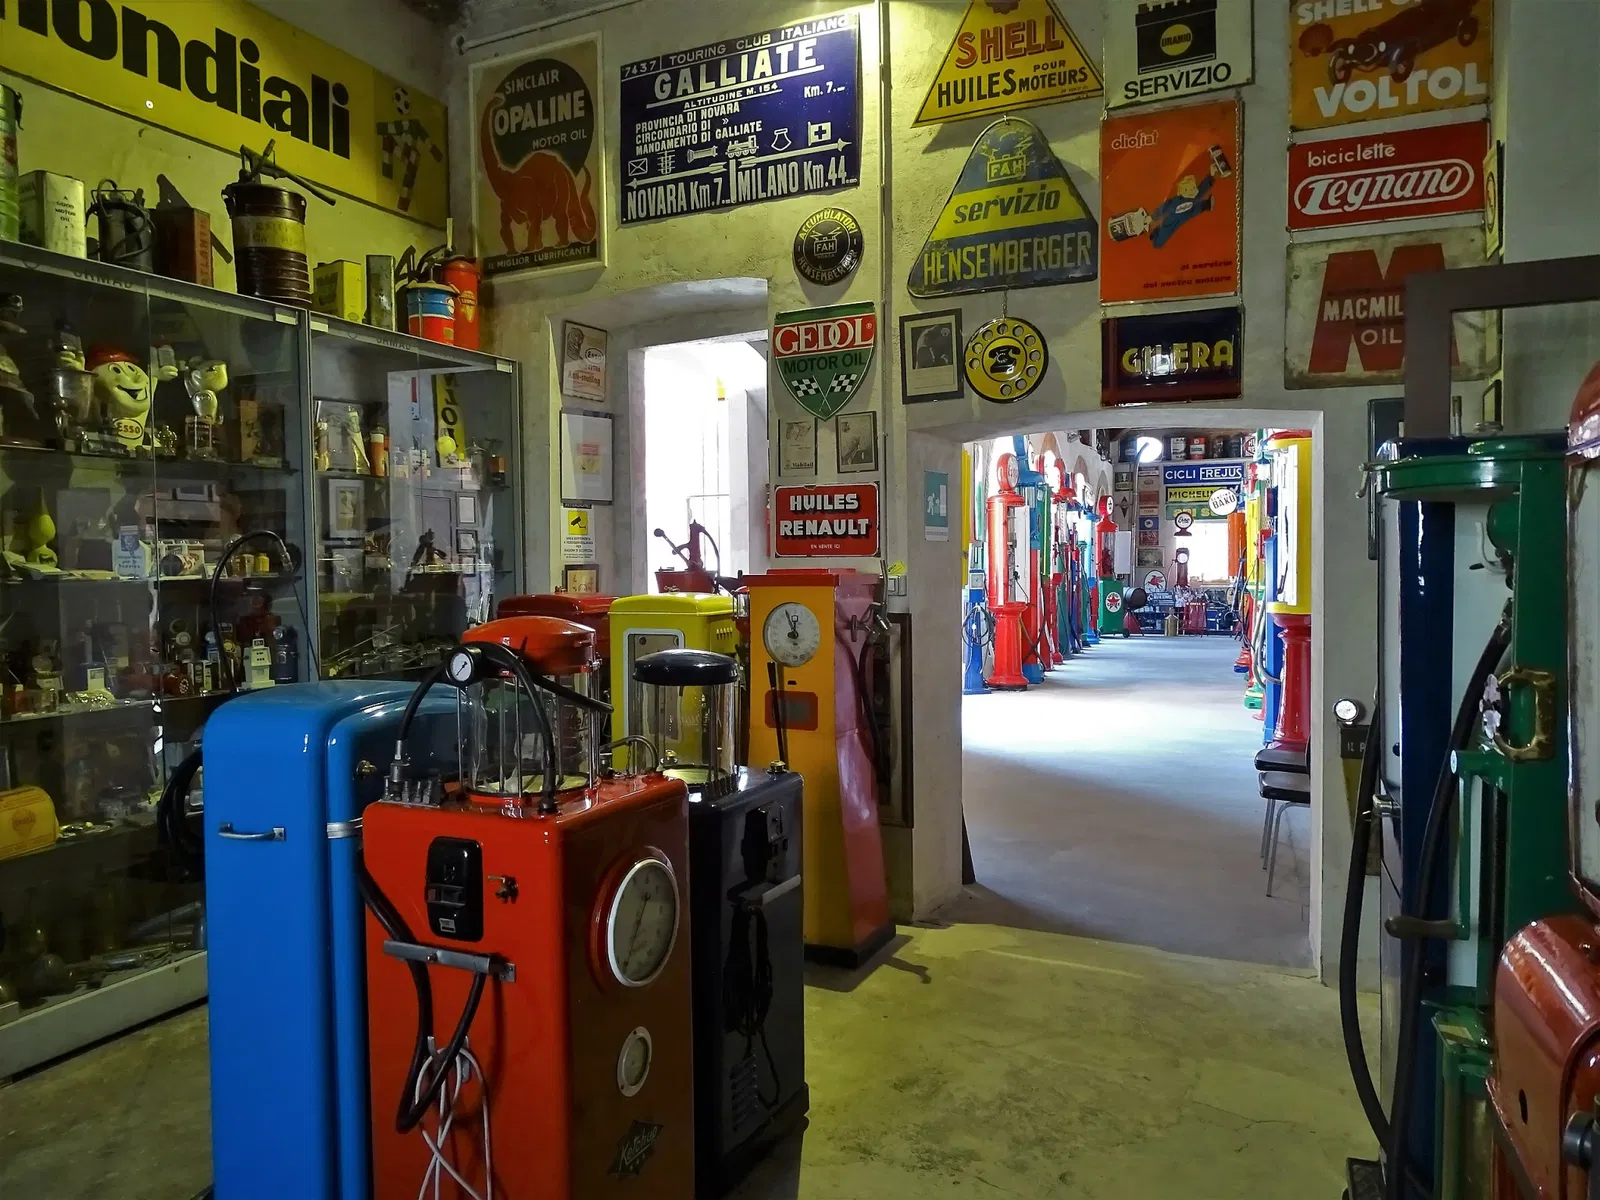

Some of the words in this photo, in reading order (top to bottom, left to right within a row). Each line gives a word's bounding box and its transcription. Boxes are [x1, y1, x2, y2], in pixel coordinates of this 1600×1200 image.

[625, 61, 656, 78] 7437
[669, 44, 726, 66] TOURING
[736, 33, 771, 50] CLUB
[781, 15, 850, 41] ITALIANO
[955, 15, 1064, 69] SHELL
[654, 38, 817, 101] GALLIATE
[1033, 60, 1066, 73] POUR
[504, 69, 559, 95] SINCLAIR
[804, 85, 824, 98] Km.
[938, 69, 1016, 108] HUILES
[1018, 66, 1088, 93] MOTEURS
[1124, 62, 1231, 100] SERVIZIO
[1313, 62, 1487, 118] VOLTOL
[494, 89, 585, 136] OPALINE
[684, 89, 743, 110] ALTITUDINE
[636, 113, 684, 134] PROVINCIA
[687, 112, 697, 123] DI
[701, 101, 740, 120] NOVARA
[532, 133, 567, 150] MOTOR
[571, 129, 587, 141] OIL
[635, 133, 698, 156] MANDAMENTO
[701, 132, 711, 143] DI
[715, 121, 762, 140] GALLIATE
[636, 123, 698, 145] CIRCONDARIO
[701, 120, 711, 132] DI
[991, 160, 1023, 178] FAH
[1308, 144, 1396, 168] biciclette
[737, 161, 799, 202] MILANO
[1301, 165, 1462, 216] Legnano
[627, 182, 687, 220] NOVARA
[953, 184, 1061, 224] servizio
[799, 209, 858, 240] ACCUMULATORI
[497, 256, 530, 268] MIGLIOR
[534, 245, 592, 262] LUBRIFICANTE
[816, 242, 835, 252] FAH
[923, 231, 1092, 286] HENSEMBERGER
[1323, 295, 1404, 322] MACMIL
[775, 318, 875, 355] GEDOL
[1361, 328, 1402, 345] OIL
[783, 356, 838, 374] MOTOR
[842, 352, 867, 367] OIL
[117, 422, 140, 434] ESSO
[1165, 470, 1196, 480] CICLI
[1201, 467, 1242, 480] FREJUS
[790, 493, 859, 511] HUILES
[1169, 490, 1215, 499] MICHELIN
[1212, 495, 1236, 509] BAKU
[780, 518, 869, 536] RENAULT
